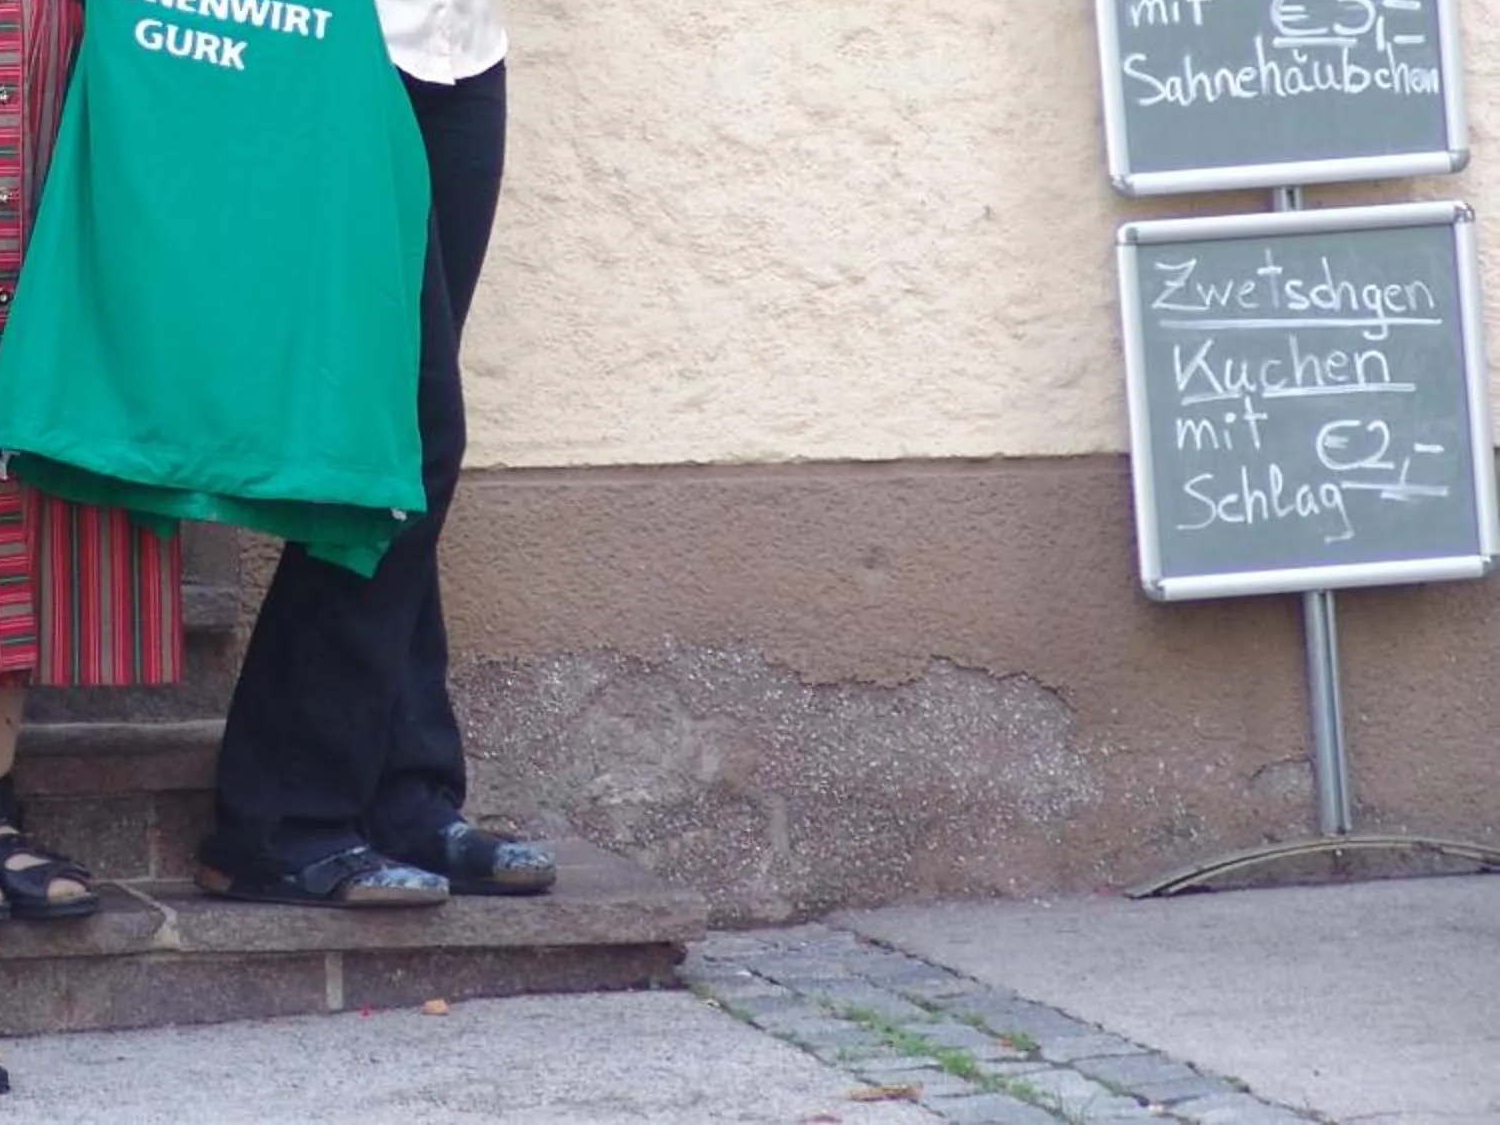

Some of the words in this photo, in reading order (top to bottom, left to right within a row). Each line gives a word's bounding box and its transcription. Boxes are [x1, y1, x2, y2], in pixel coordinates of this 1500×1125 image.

[135, 19, 248, 70] GURK
[1152, 248, 1435, 340] Zwetschgen
[1173, 333, 1390, 394] Kuchen
[1177, 396, 1267, 452] mit
[1176, 464, 1353, 543] Schlag
